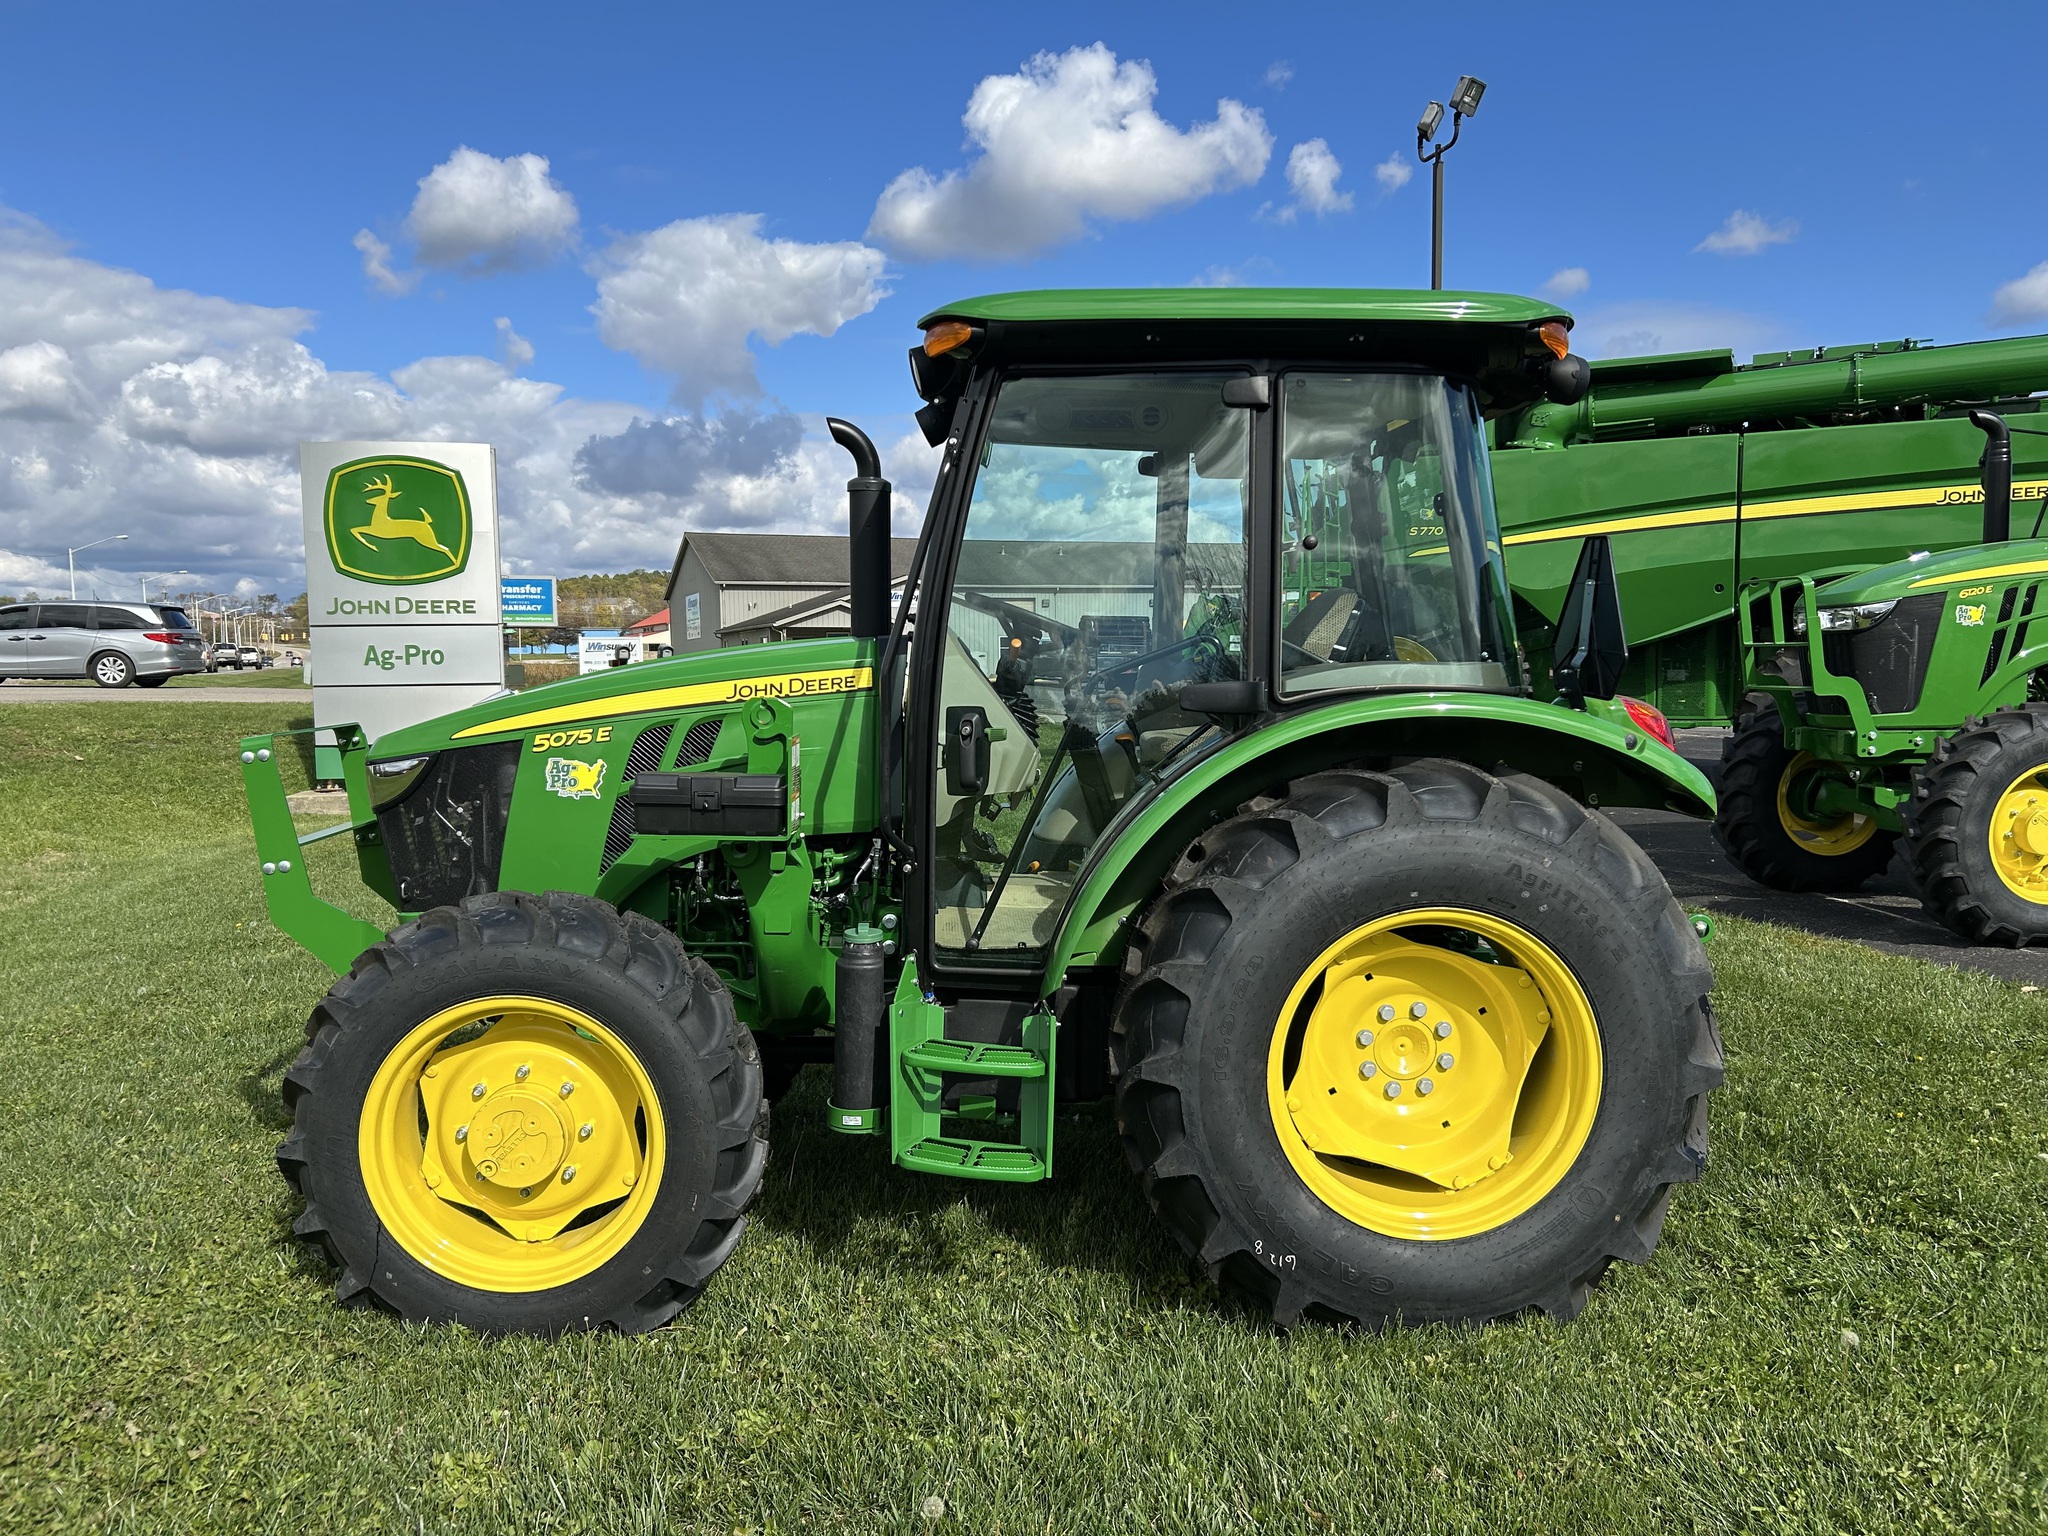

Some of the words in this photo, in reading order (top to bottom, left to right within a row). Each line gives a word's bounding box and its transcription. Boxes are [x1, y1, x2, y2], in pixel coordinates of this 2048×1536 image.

[2012, 486, 2048, 499] EER
[1420, 526, 1444, 536] 770
[501, 584, 542, 594] ransfer
[1985, 585, 1994, 594] E
[326, 597, 391, 616] JOHN
[395, 596, 477, 615] DEERE
[587, 641, 637, 653] Winsuly
[364, 644, 445, 671] Ag-Pro
[726, 682, 784, 700] JOHN
[789, 676, 857, 695] DEERE
[532, 728, 594, 754] 5075
[596, 725, 614, 744] E
[549, 760, 578, 777] Ag-
[549, 774, 579, 789] Pro
